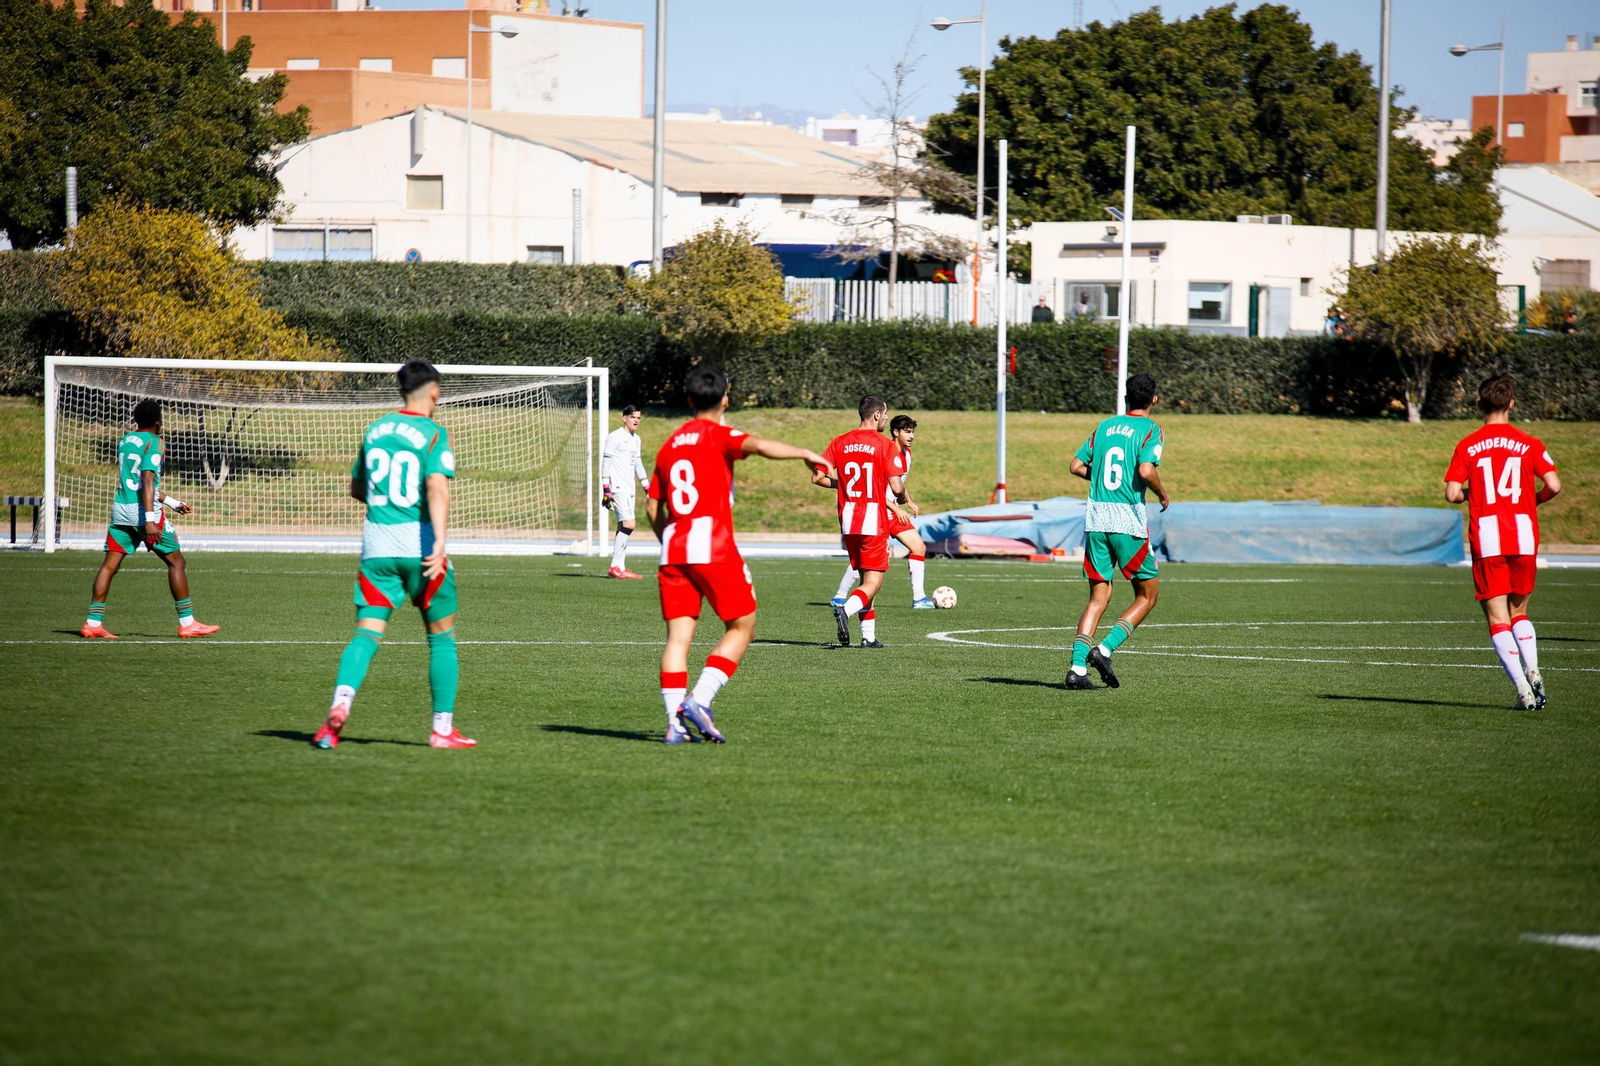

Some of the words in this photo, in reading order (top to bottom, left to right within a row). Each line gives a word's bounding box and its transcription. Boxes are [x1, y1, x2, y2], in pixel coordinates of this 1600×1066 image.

[843, 443, 876, 456] JOSEMA
[1105, 424, 1135, 439] ULLOA
[1467, 437, 1531, 457] SVIDERSKY
[118, 452, 142, 491] 13
[365, 447, 420, 508] 20
[670, 459, 700, 515] 8
[844, 461, 873, 499] 21
[1103, 446, 1125, 491] 6
[1476, 456, 1522, 505] 14
